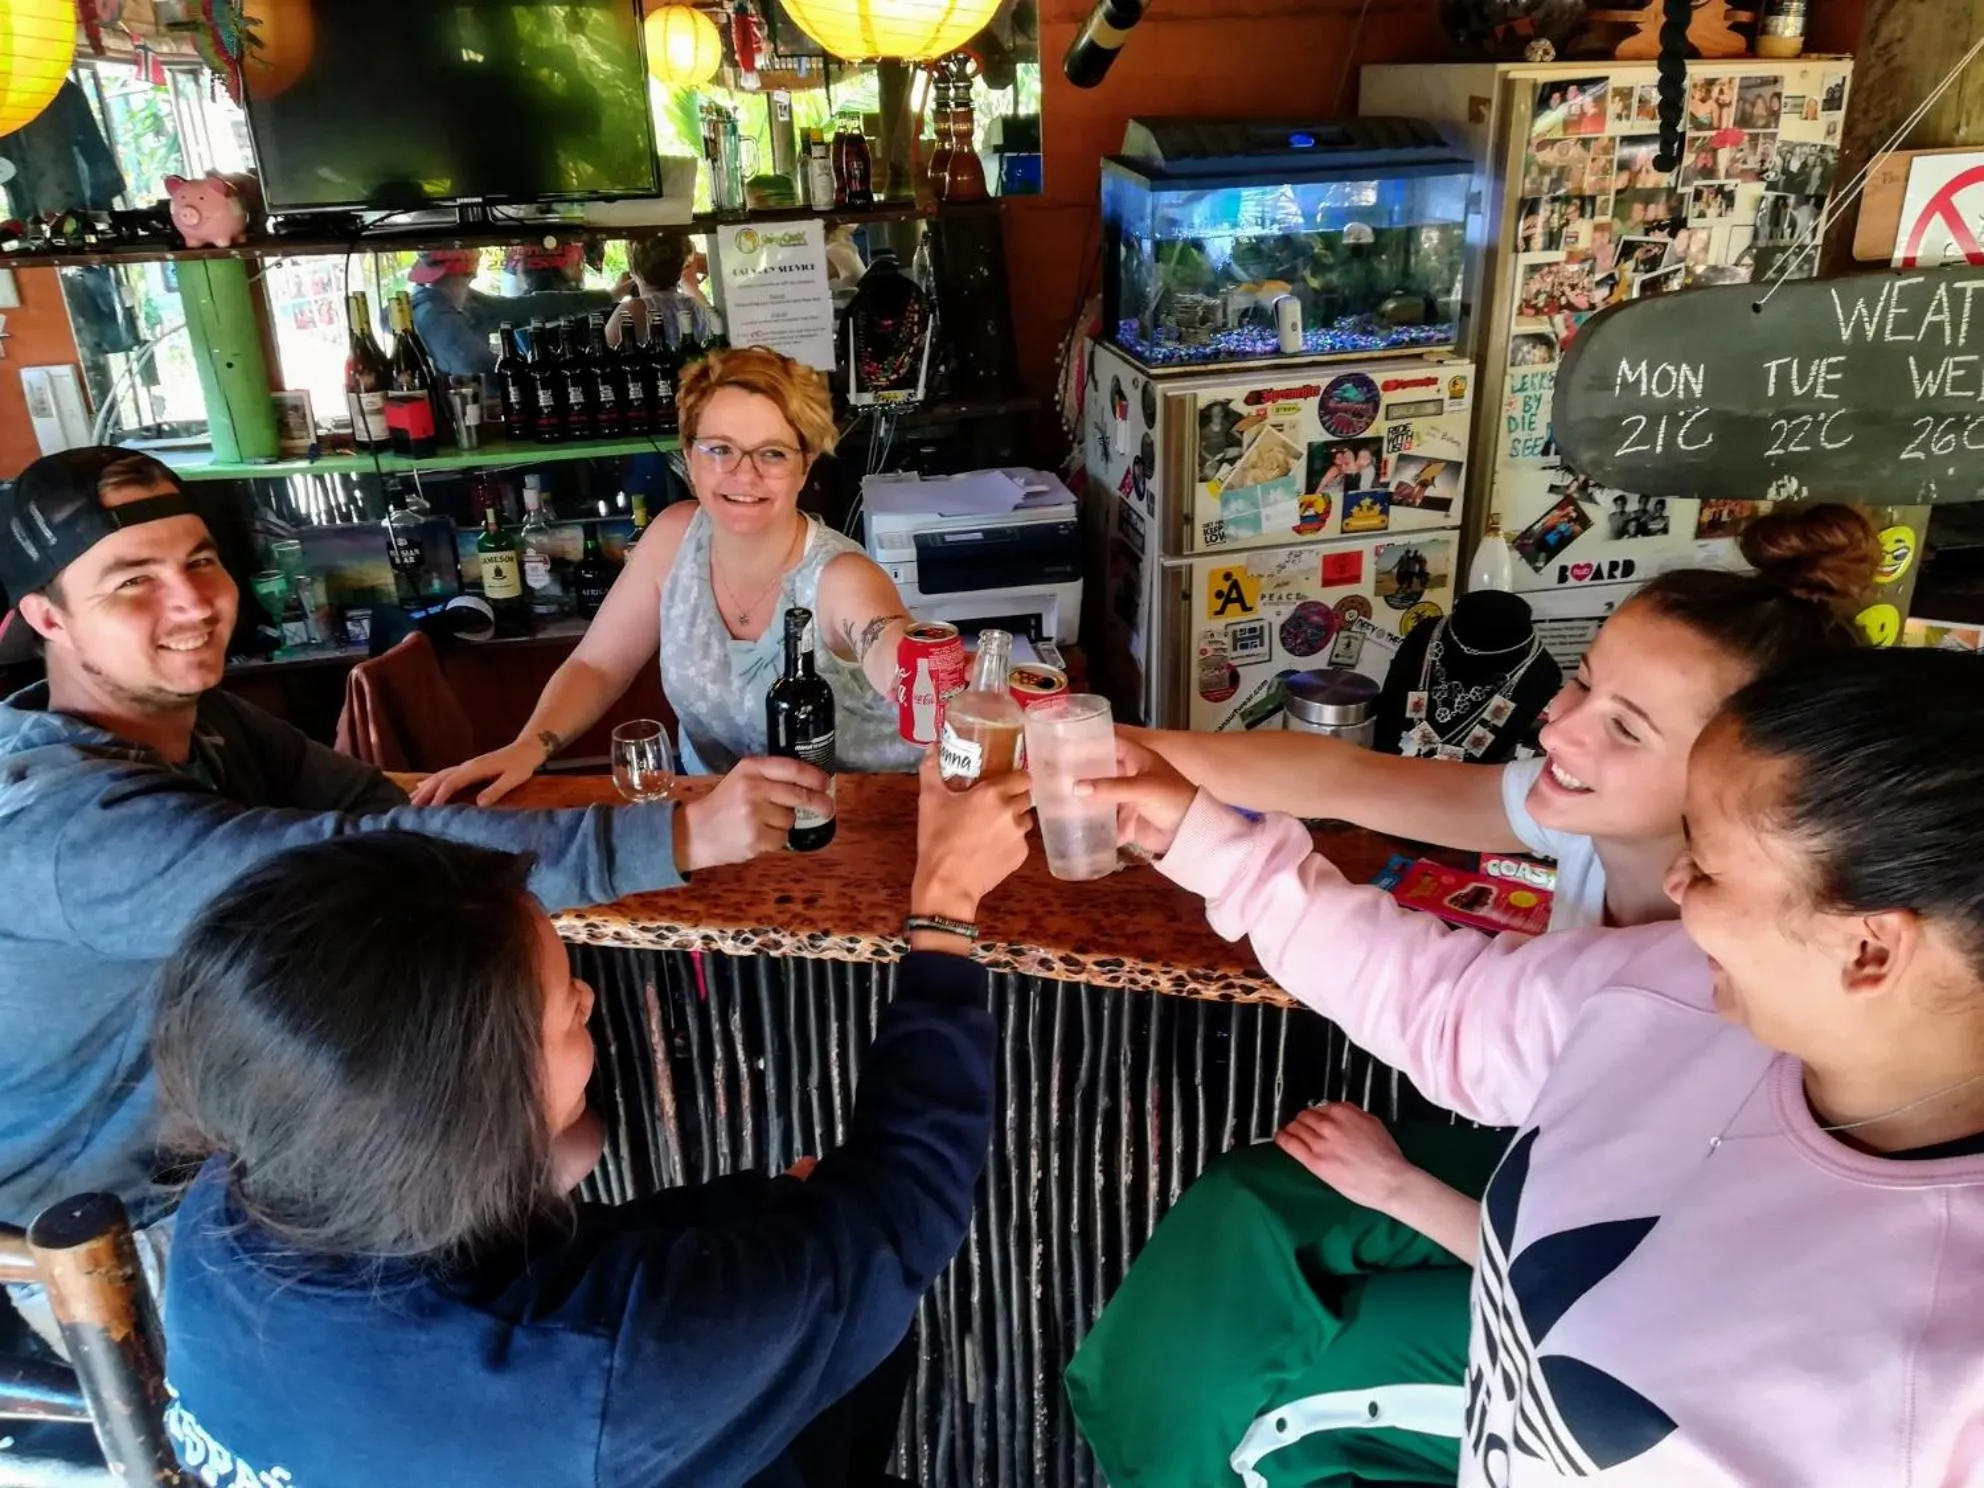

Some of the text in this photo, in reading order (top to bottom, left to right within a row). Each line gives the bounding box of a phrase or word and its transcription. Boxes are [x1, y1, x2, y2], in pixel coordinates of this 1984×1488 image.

[778, 263, 815, 273] SERVICE
[1832, 276, 1984, 347] WEAT
[1614, 355, 1984, 401] MON TUE WE
[1523, 393, 1543, 413] BY
[1507, 414, 1537, 433] DIE
[1509, 437, 1545, 457] SEE
[1261, 592, 1302, 601] PEACE
